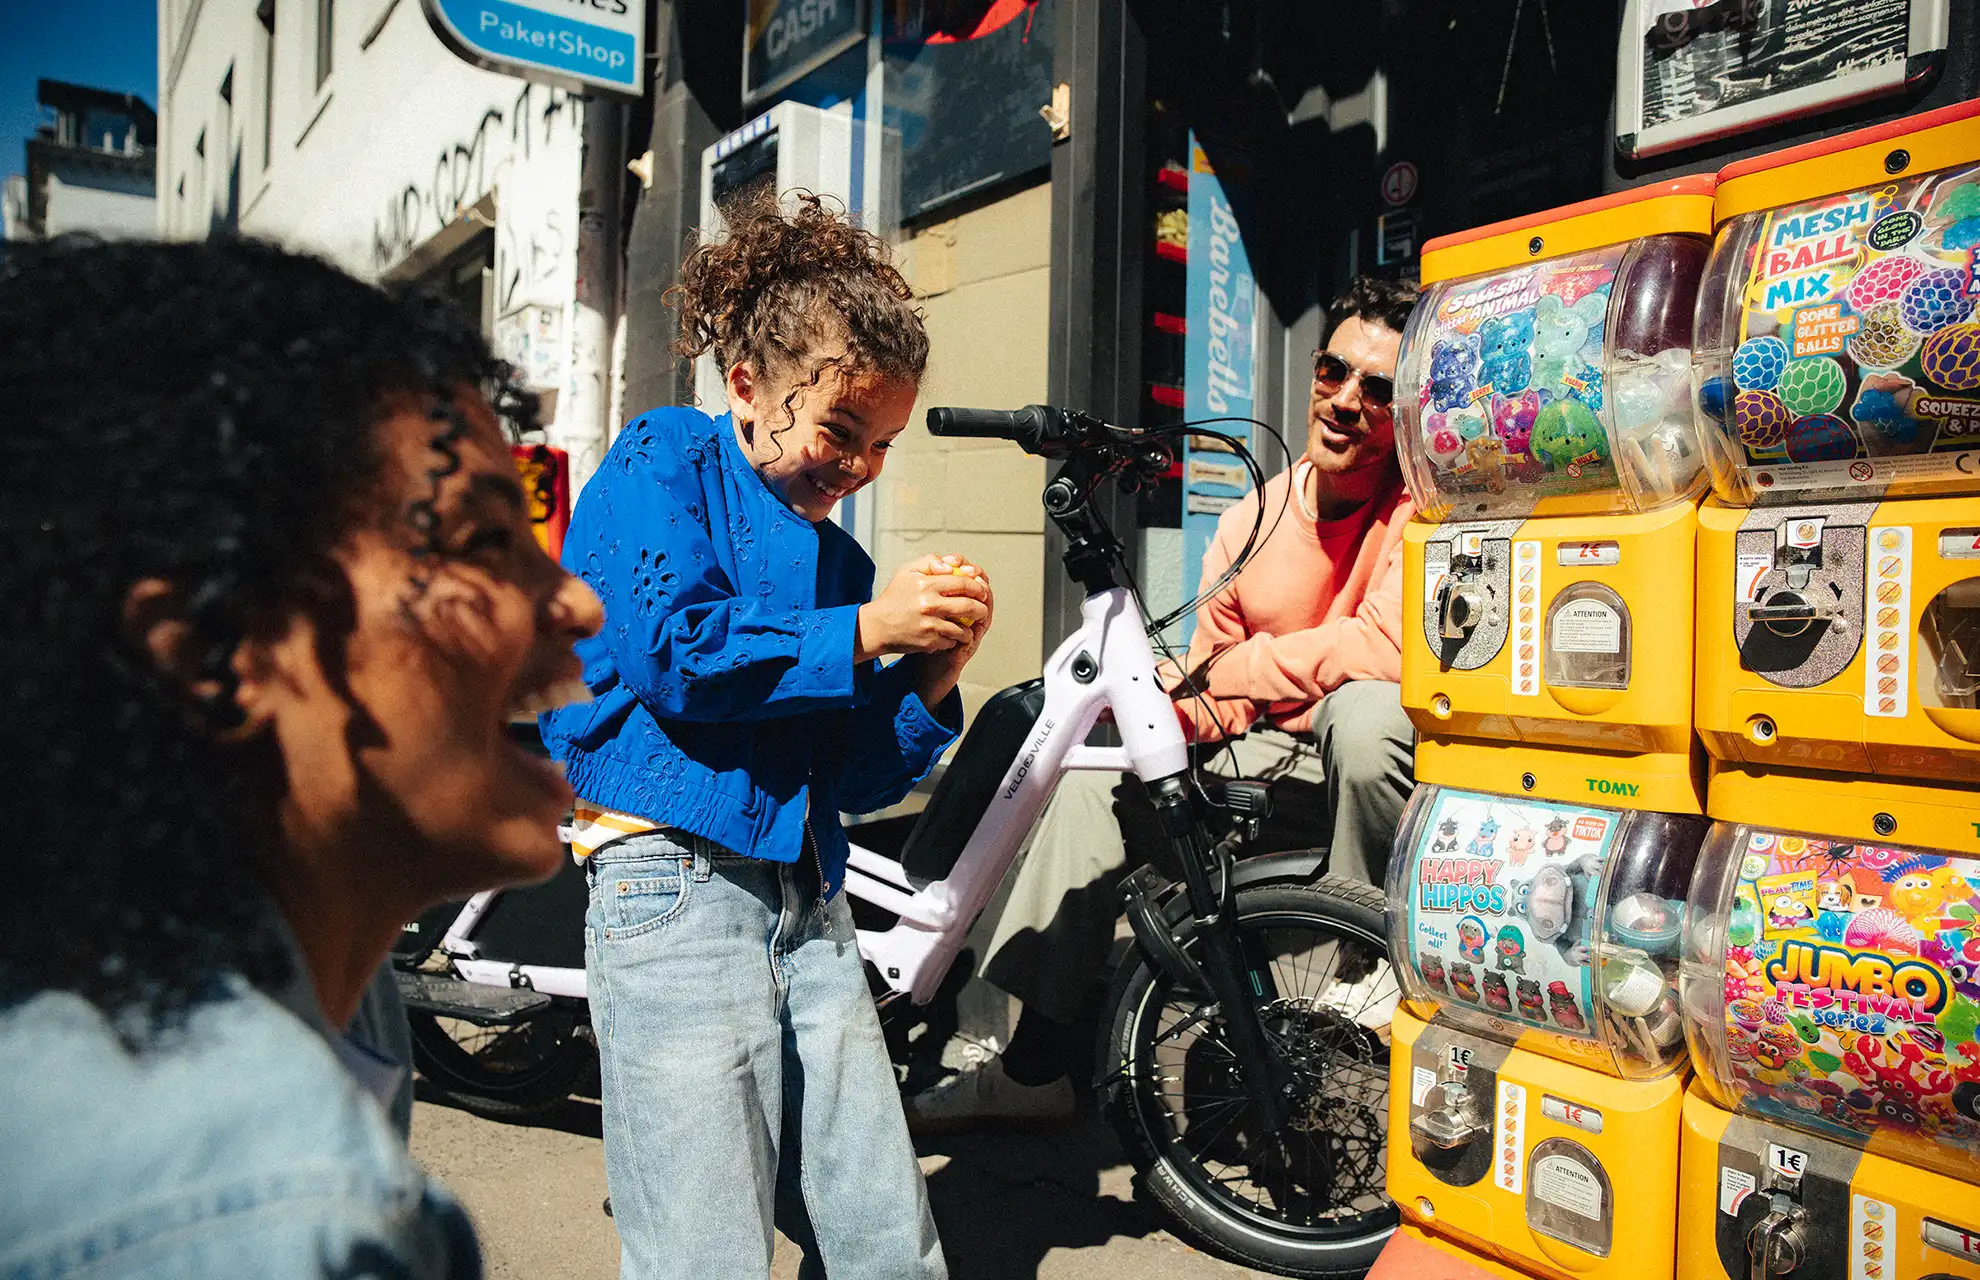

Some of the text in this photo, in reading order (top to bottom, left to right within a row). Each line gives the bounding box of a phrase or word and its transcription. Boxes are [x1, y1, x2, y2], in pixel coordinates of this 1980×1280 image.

[480, 10, 626, 69] PaketShop
[1773, 202, 1871, 248] MESH
[1878, 221, 1907, 234] GLOW
[1881, 214, 1909, 226] SOME
[1877, 226, 1911, 241] IN THE
[1880, 235, 1906, 247] DARK
[1768, 234, 1855, 276] BALL
[1766, 273, 1831, 310] MIX
[1206, 196, 1240, 414] Barebells
[1798, 305, 1839, 324] SOME
[1433, 315, 1468, 341] glitter
[1796, 320, 1857, 340] GLITTER
[1795, 337, 1841, 356] BALLS
[1949, 419, 1962, 432] &
[1576, 454, 1595, 466] HULK
[1579, 543, 1600, 558] 2€
[1573, 610, 1607, 618] ATTENTION
[1586, 778, 1640, 797] TOMY
[1575, 825, 1603, 839] TIKTOK
[1421, 858, 1503, 884] HAPPY
[1790, 880, 1813, 891] TIME
[1421, 884, 1505, 914] HIPPOS
[1419, 922, 1447, 940] Collect
[1428, 940, 1443, 950] all!
[1769, 942, 1943, 1011] JUMBO
[1775, 982, 1936, 1025] FESTIVAL
[1452, 1047, 1471, 1065] 1€
[1564, 1105, 1582, 1123] 1€
[1778, 1150, 1800, 1171] 1€
[1556, 1165, 1589, 1183] ATTENTION
[1153, 1159, 1197, 1210] SCHWAL
